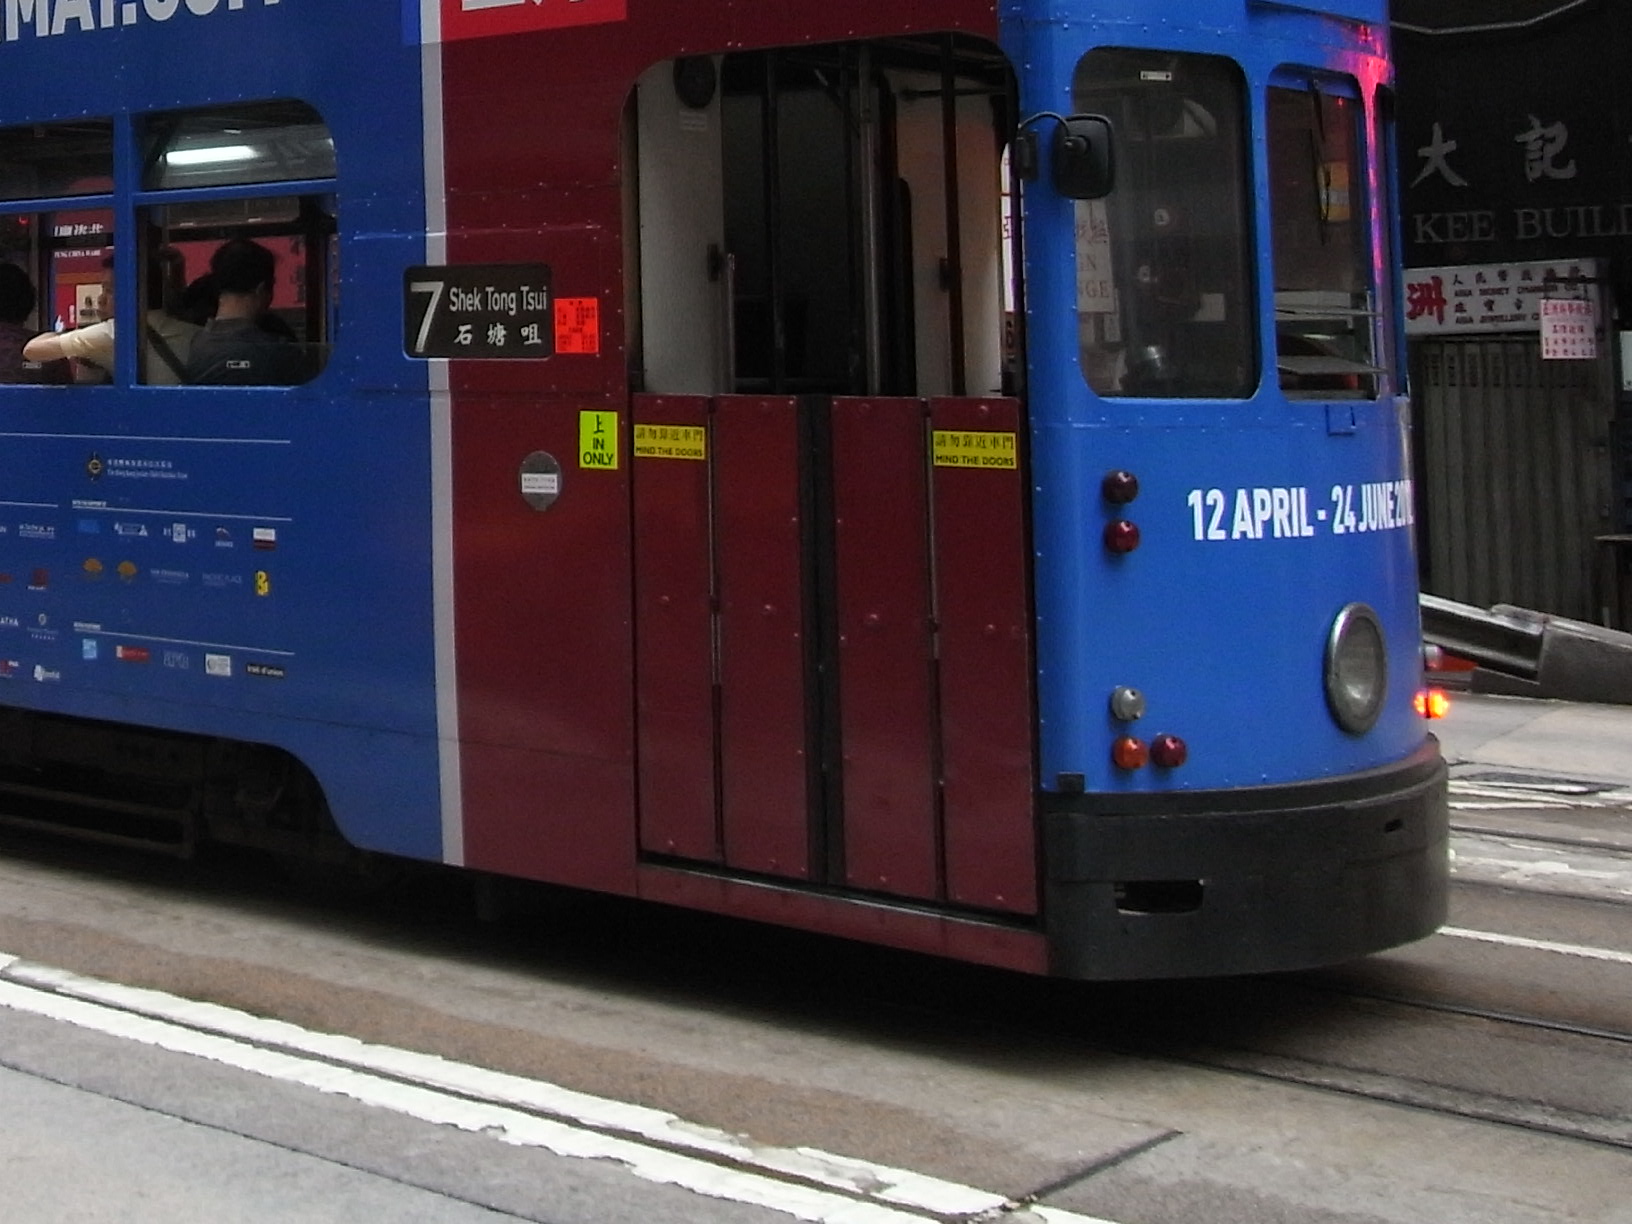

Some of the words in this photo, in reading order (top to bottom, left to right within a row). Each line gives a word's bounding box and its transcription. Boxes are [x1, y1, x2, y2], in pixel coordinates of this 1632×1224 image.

[1413, 210, 1496, 244] KEE
[410, 280, 445, 353] 7
[449, 286, 483, 313] Shek
[485, 285, 518, 317] Tong
[520, 285, 548, 311] Tsui
[453, 322, 543, 346] 石塘咀
[593, 414, 604, 435] 上
[592, 437, 605, 451] IN
[582, 450, 615, 467] ONLY
[935, 453, 961, 465] MIND
[962, 454, 980, 466] THE
[981, 455, 1016, 468] DOORS
[1186, 487, 1227, 542] 12
[1232, 487, 1314, 541] APRIL
[1330, 483, 1357, 536] 24
[1356, 479, 1395, 534] JUNE
